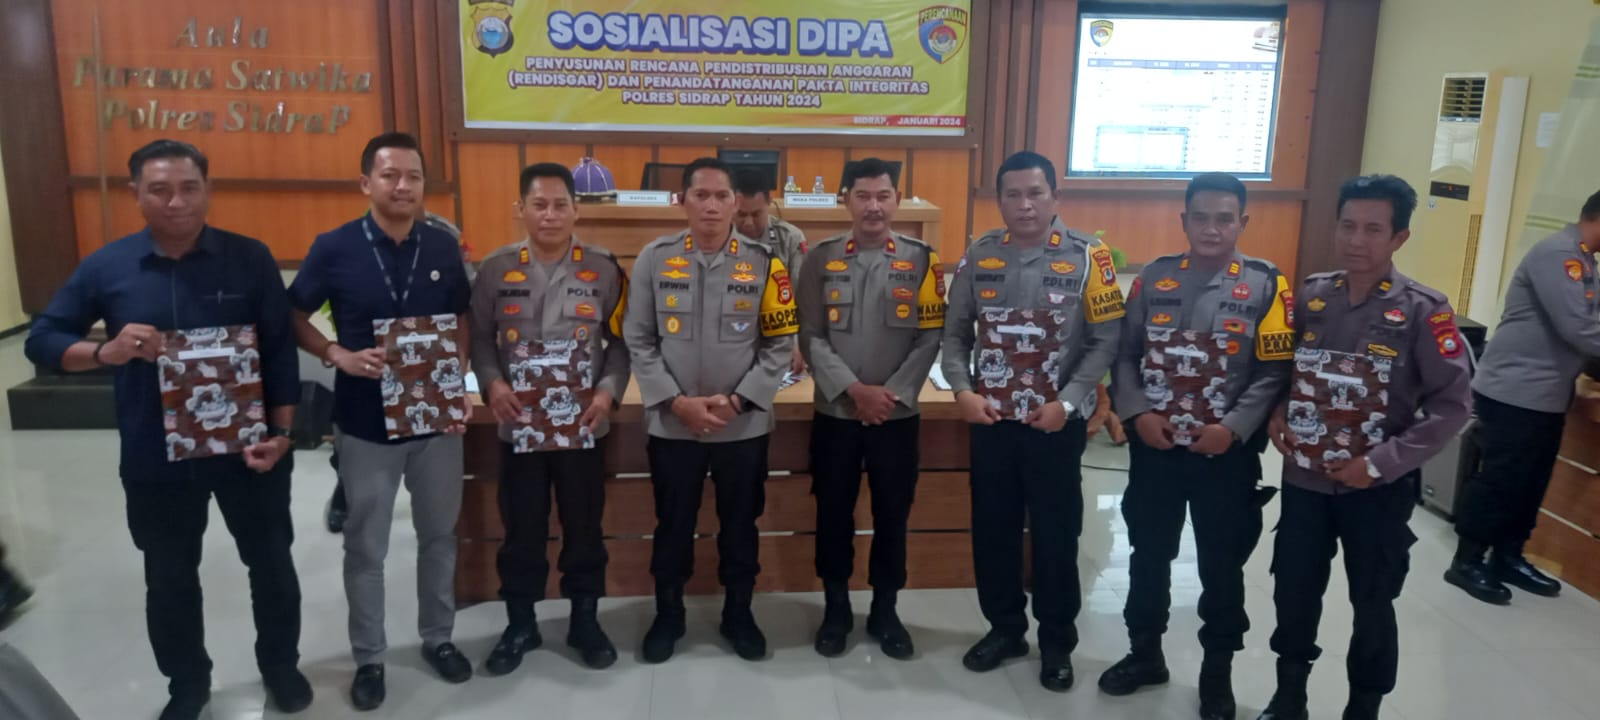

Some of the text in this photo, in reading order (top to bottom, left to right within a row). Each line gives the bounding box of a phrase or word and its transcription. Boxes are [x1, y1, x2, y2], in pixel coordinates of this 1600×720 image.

[174, 16, 270, 48] Aula
[548, 11, 892, 56] SOSIALISASI DIPA
[73, 56, 372, 93] Parama Satwika
[525, 56, 913, 78] PENYUSUNAN RENCANA PENDISTRIBUSIAN ANGGARAN
[508, 70, 930, 94] (RENDISGAR) DAN PENANDATANGANAN PAKTA INTEGRITAS
[622, 91, 822, 107] POLRES SIDRAP TAHUN 2024
[102, 100, 215, 131] Polres
[897, 116, 939, 126] JANUARI
[939, 117, 961, 126] 2024
[659, 281, 690, 291] ERWIN
[727, 284, 759, 295] POLRI
[1042, 276, 1078, 290] POLRI
